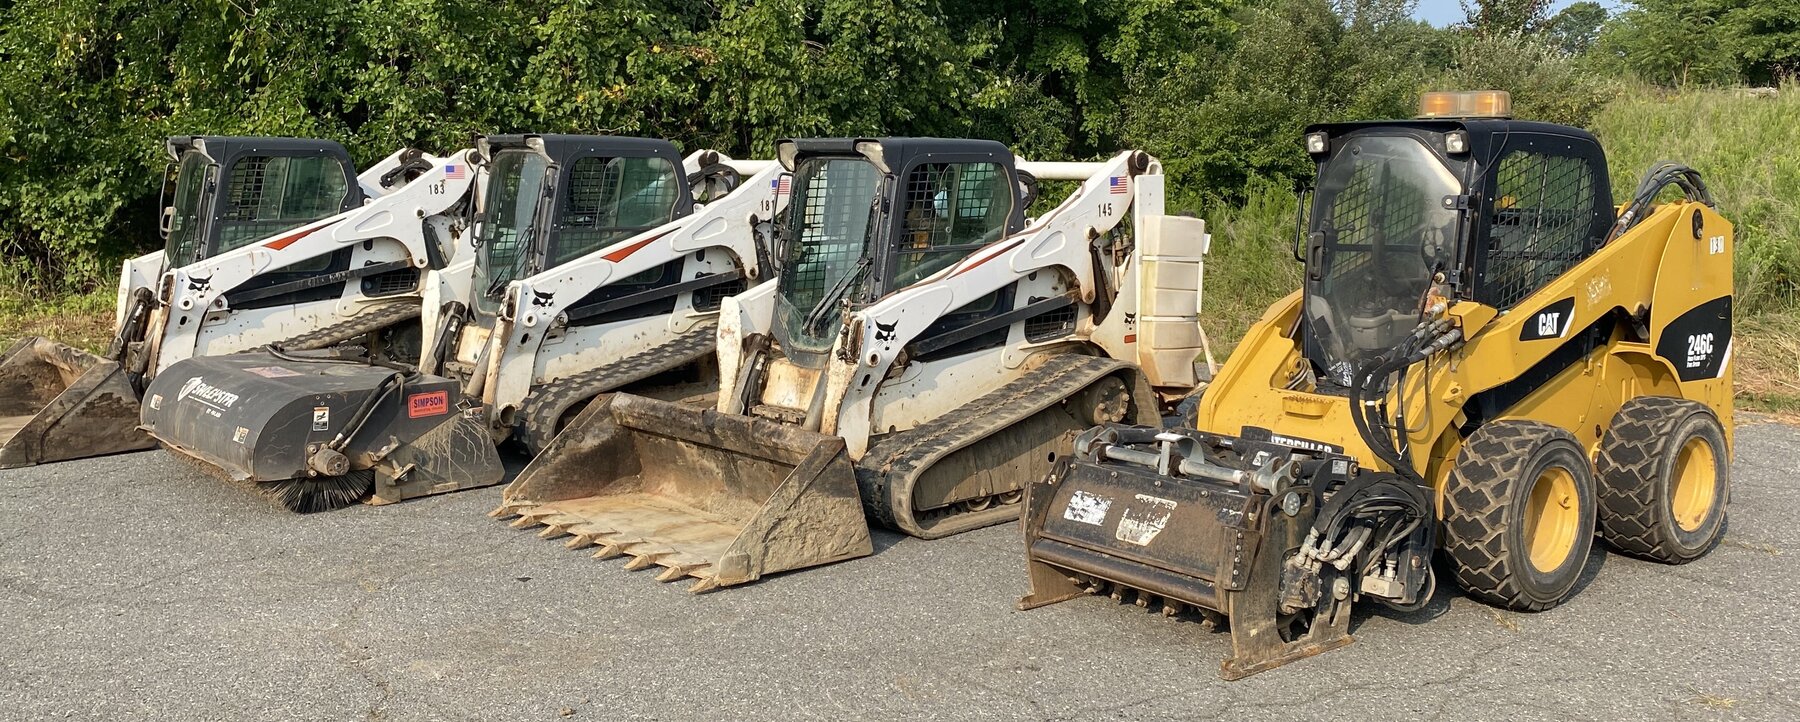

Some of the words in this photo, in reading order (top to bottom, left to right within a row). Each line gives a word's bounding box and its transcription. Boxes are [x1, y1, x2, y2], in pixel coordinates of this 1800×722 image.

[428, 183, 445, 195] 183
[1097, 202, 1112, 218] 145
[1538, 312, 1560, 337] CAT
[1687, 332, 1714, 356] 246C
[413, 395, 444, 409] SIMPSON
